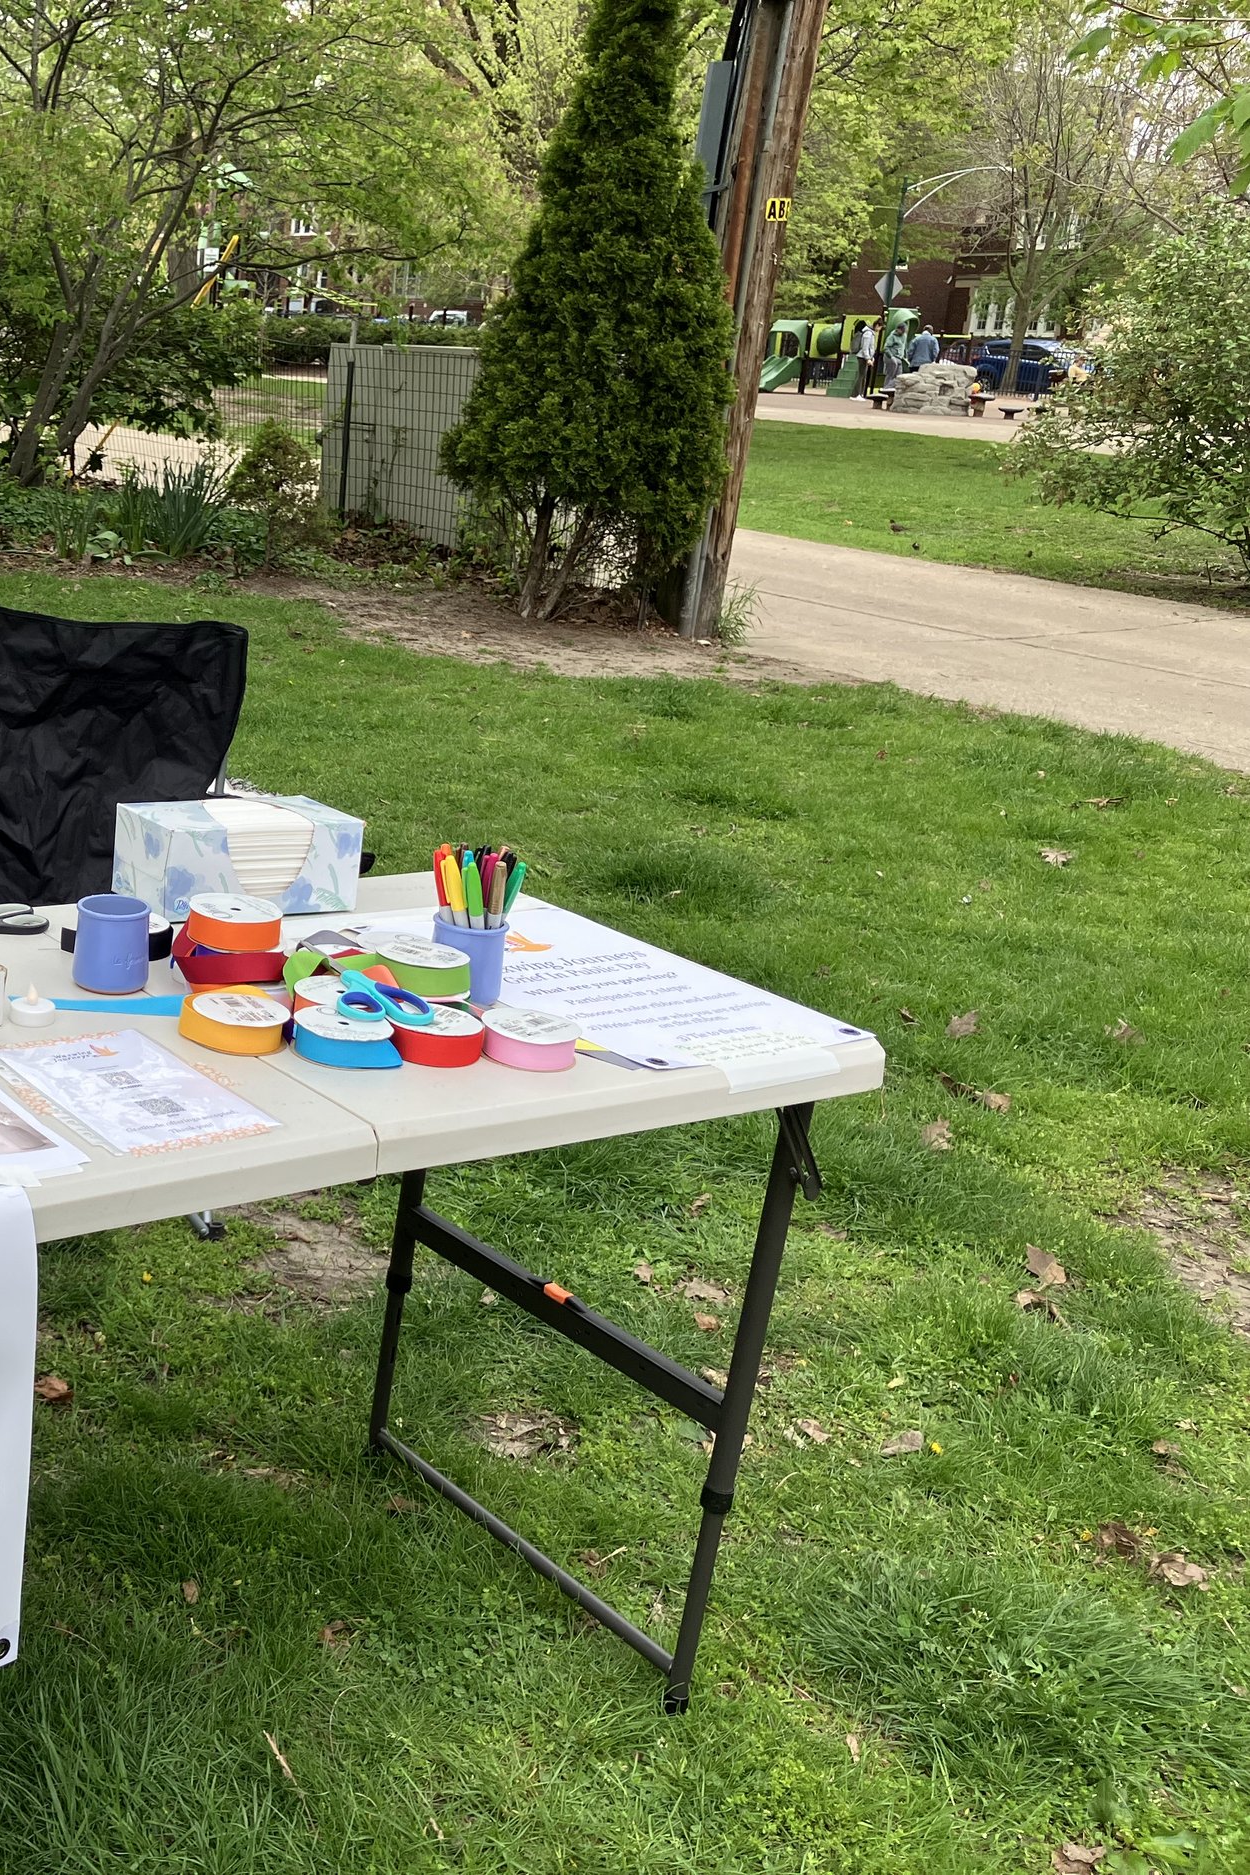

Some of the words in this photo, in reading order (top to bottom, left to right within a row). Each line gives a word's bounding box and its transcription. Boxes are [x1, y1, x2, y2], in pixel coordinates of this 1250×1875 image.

[502, 960, 564, 974] xwing
[558, 950, 648, 968] Journeys
[503, 971, 547, 985] Grief
[546, 969, 567, 980] In
[565, 963, 620, 977] Public
[618, 960, 652, 973] Day
[524, 986, 563, 996] What
[592, 980, 617, 988] you
[616, 971, 679, 985] grieving?
[568, 992, 632, 1006] Participate
